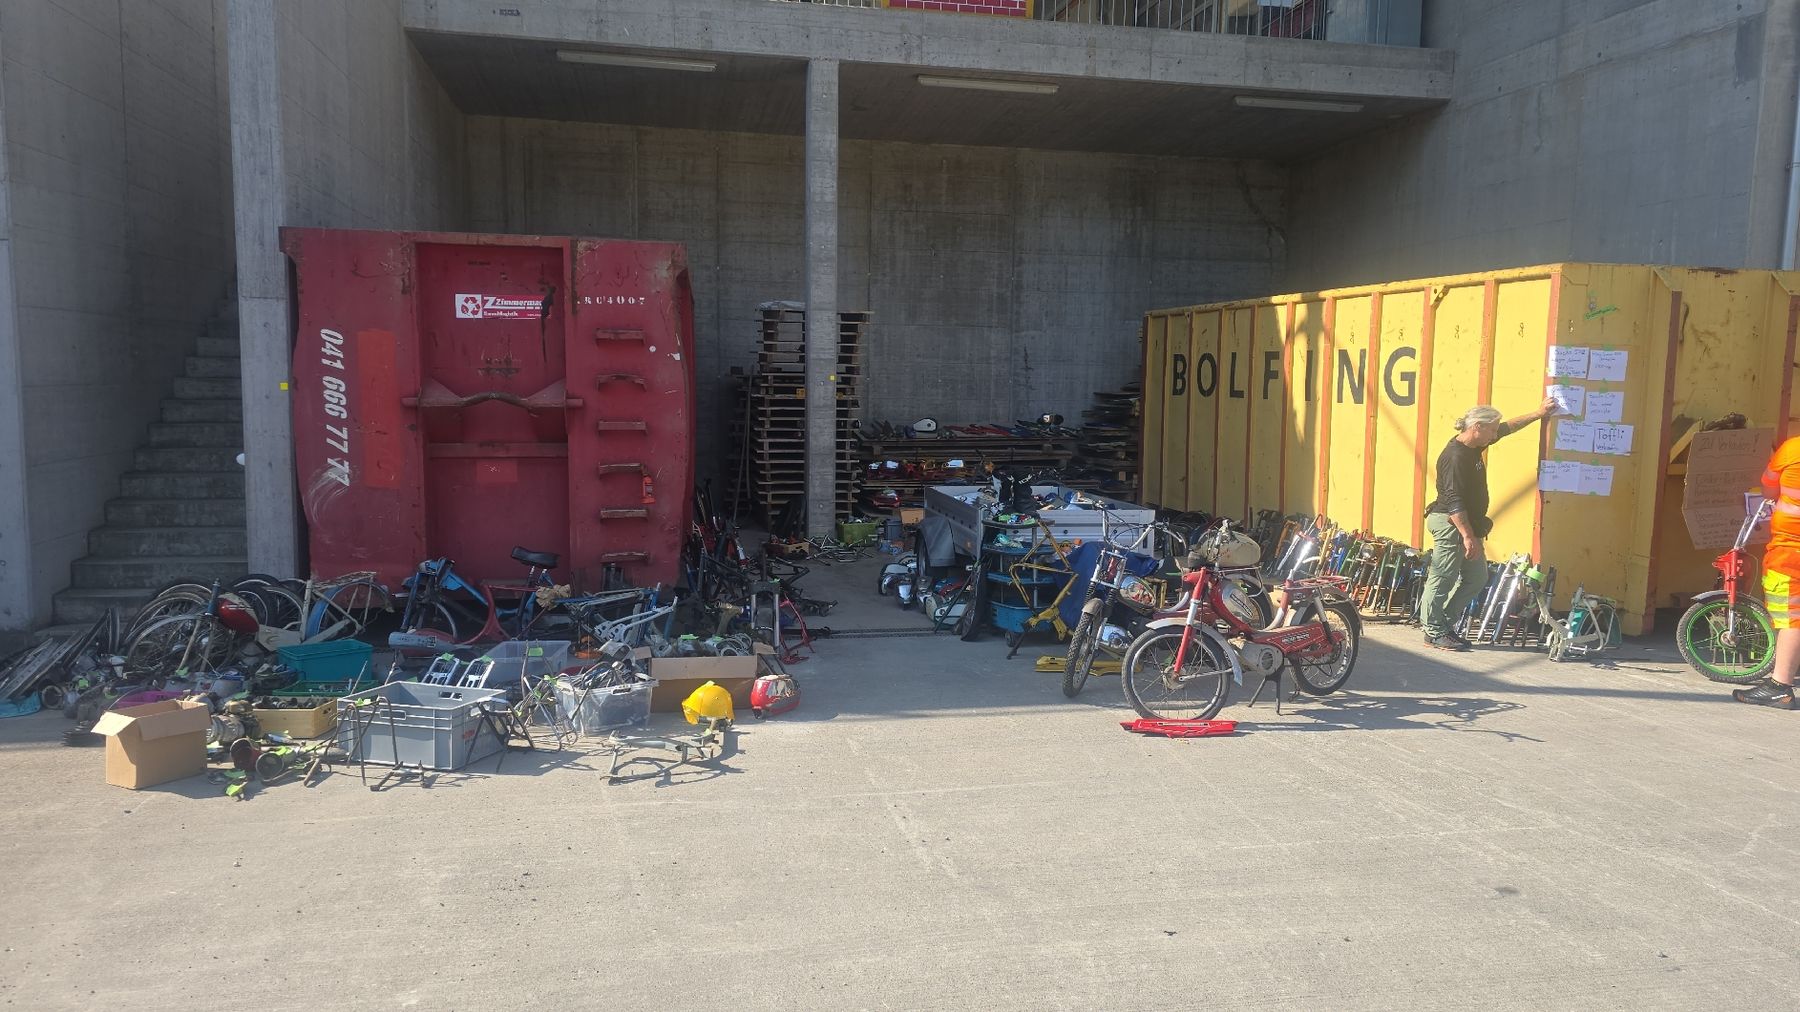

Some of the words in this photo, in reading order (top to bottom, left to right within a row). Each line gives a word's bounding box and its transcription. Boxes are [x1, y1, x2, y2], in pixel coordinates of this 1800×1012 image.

[320, 328, 345, 370] 041
[322, 375, 347, 419] 666
[1172, 346, 1417, 407] BOLFING
[326, 424, 348, 453] 77
